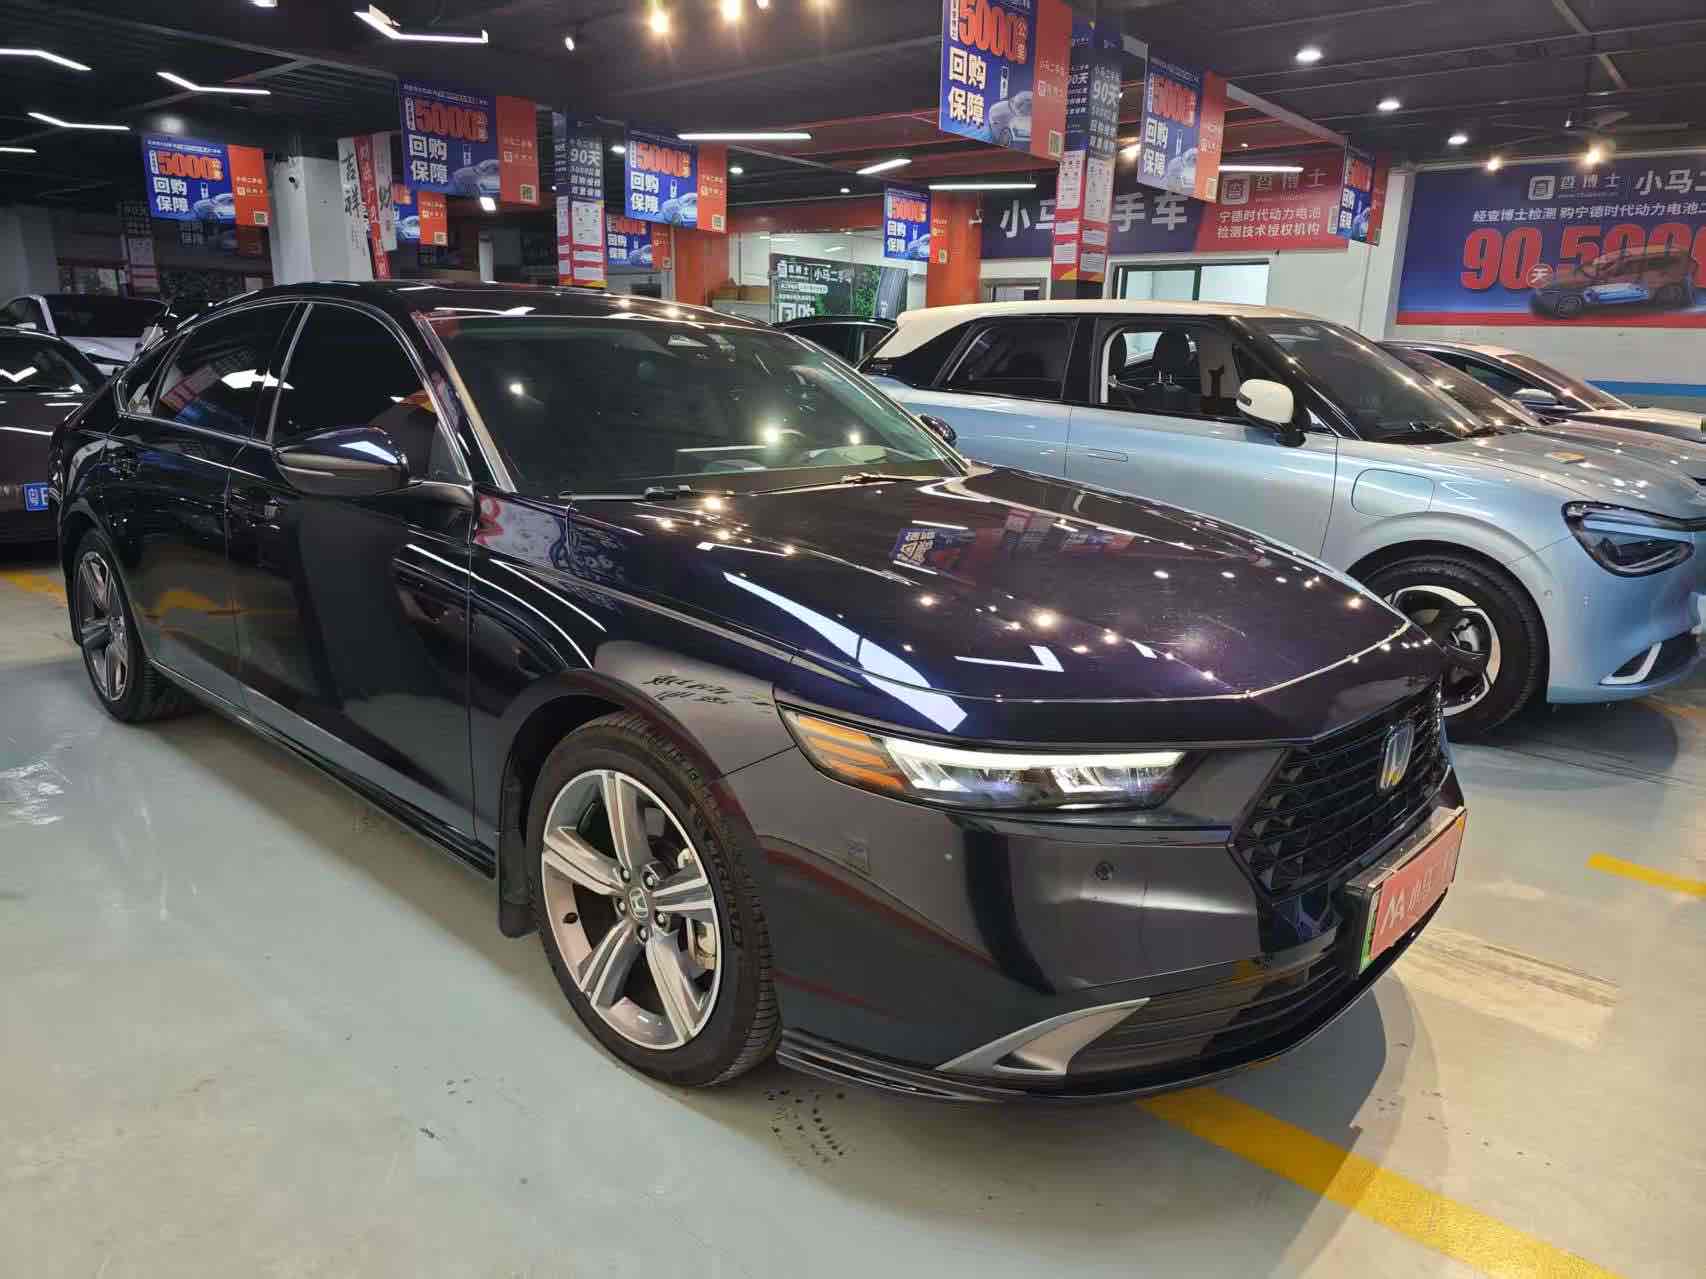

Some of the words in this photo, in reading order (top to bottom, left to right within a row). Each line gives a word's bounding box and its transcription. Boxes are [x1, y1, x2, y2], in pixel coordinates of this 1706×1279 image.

[949, 47, 986, 90] 回购
[1092, 80, 1120, 106] 90天
[948, 86, 985, 128] 保障
[1144, 117, 1169, 151] 回购
[408, 134, 448, 161] 回购
[569, 148, 601, 167] 90天
[410, 159, 449, 185] 保障
[1143, 147, 1166, 178] 保障
[153, 176, 187, 195] 回购
[630, 171, 659, 193] 回购
[156, 195, 189, 213] 保障
[631, 192, 660, 215] 保障
[999, 191, 1189, 238] 小马手车
[1218, 207, 1322, 224] 宁德时代动力电池
[1472, 206, 1557, 223] 经查博士检测
[1216, 223, 1321, 240] 检测技术授权机构
[1460, 226, 1543, 291] 90
